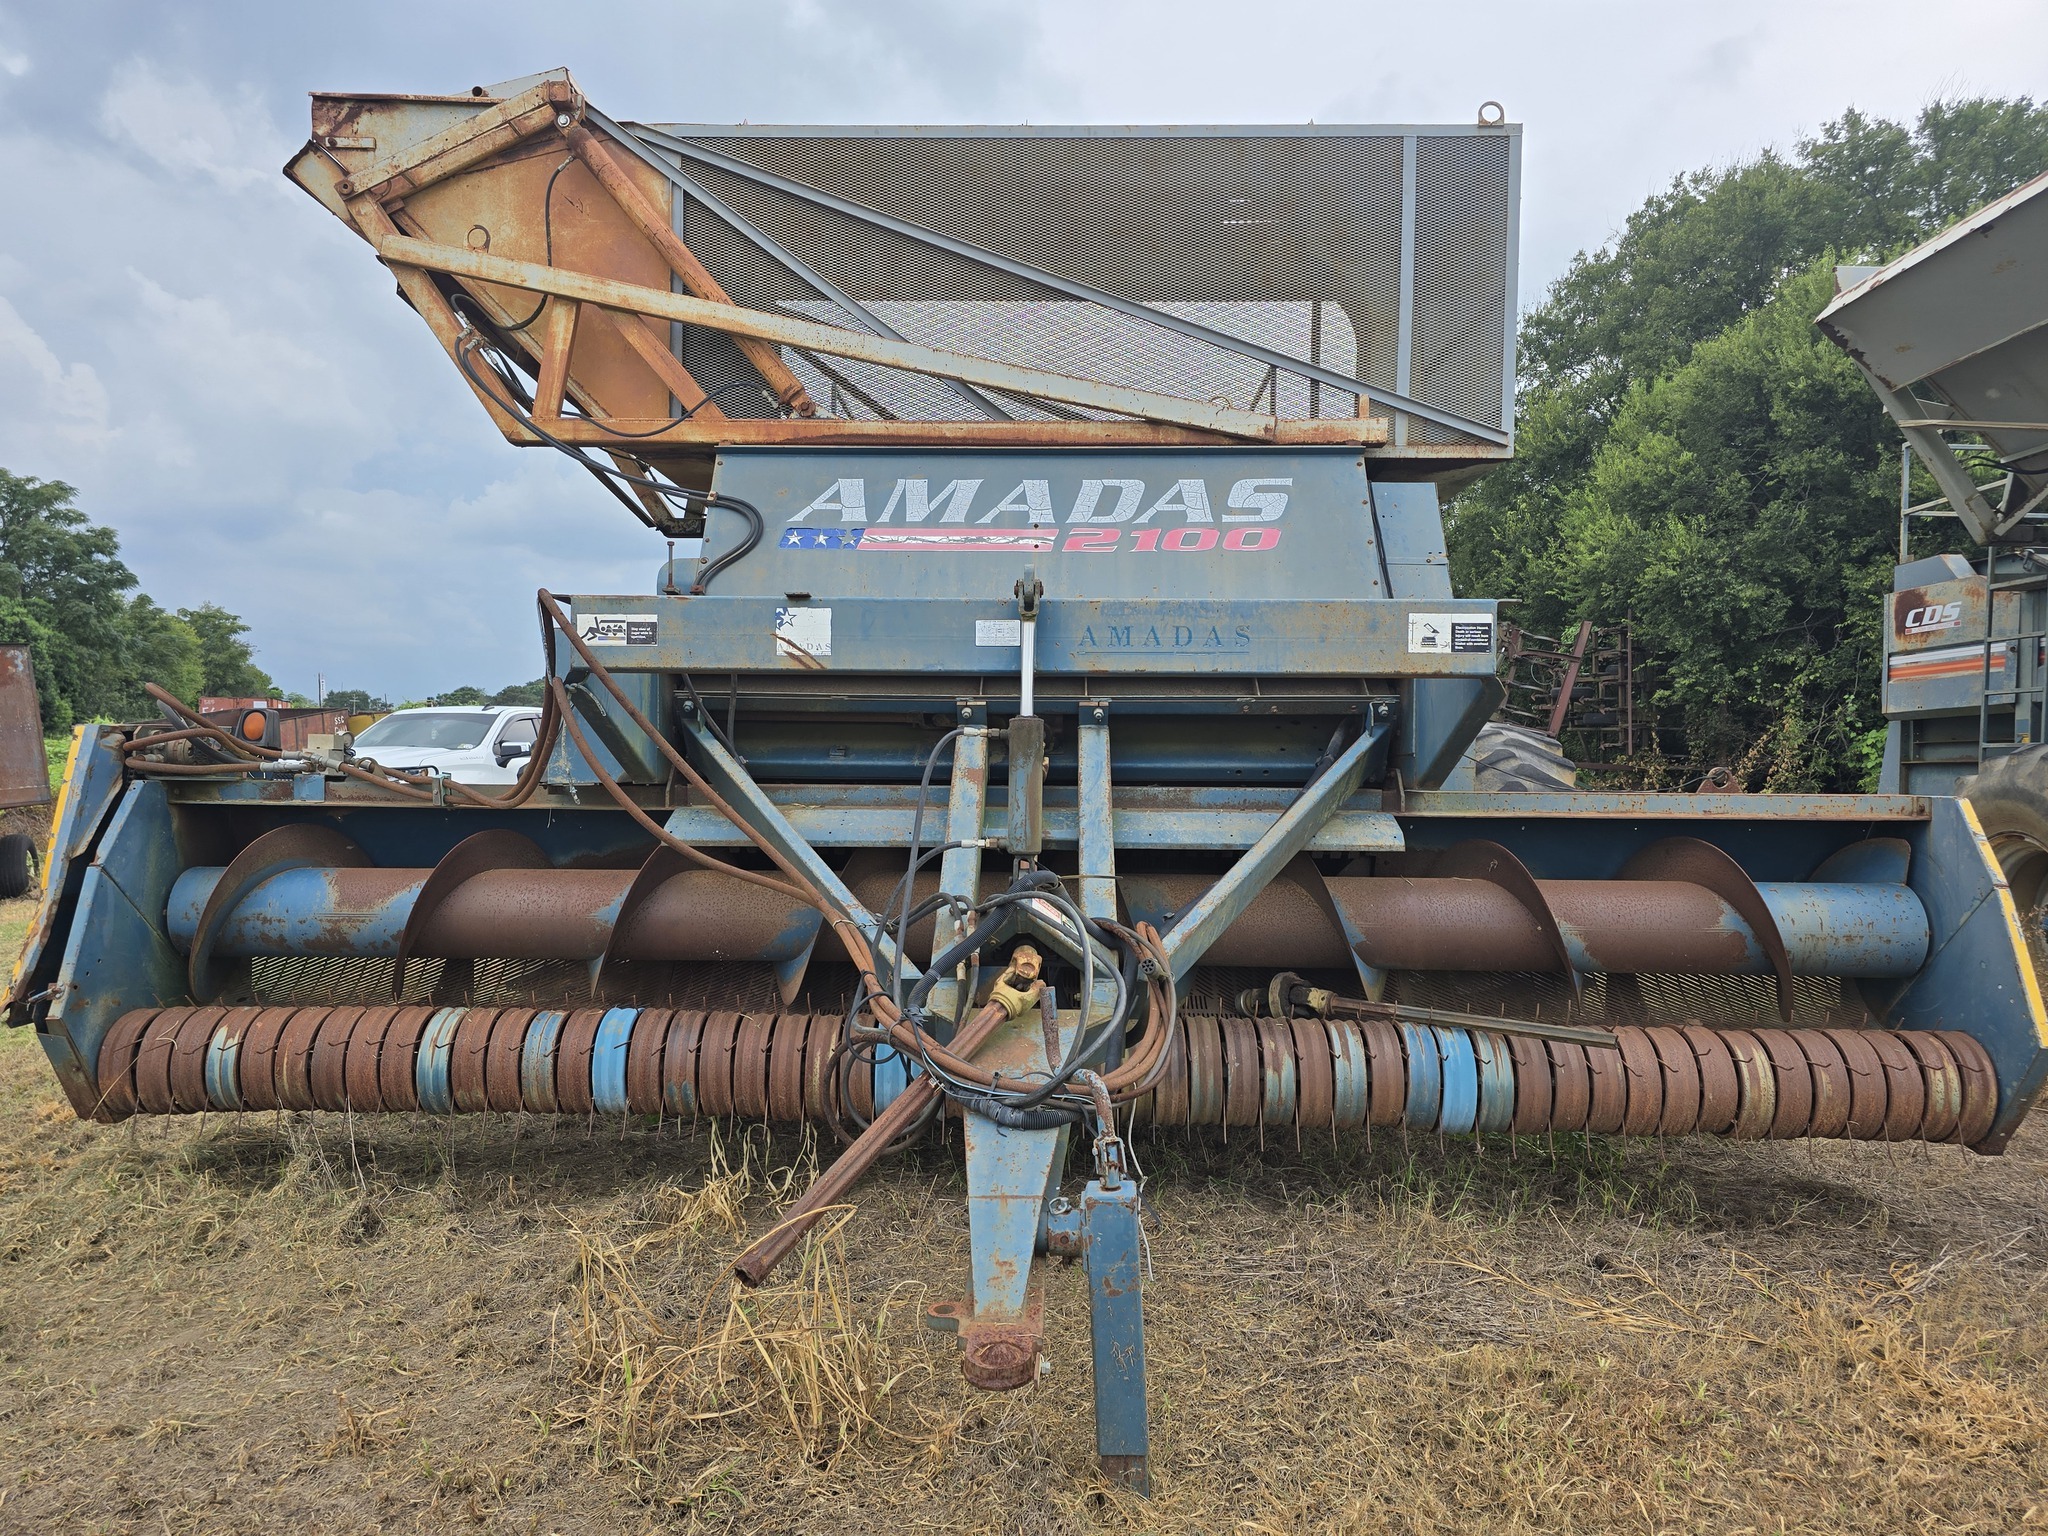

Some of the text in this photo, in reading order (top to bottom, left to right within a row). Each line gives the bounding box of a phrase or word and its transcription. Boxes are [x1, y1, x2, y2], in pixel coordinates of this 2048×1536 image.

[786, 478, 1294, 524] AMADAS
[1061, 527, 1283, 553] 2100
[1905, 601, 1963, 628] CDS
[777, 642, 831, 651] ADAS
[1078, 624, 1251, 648] AMADAS
